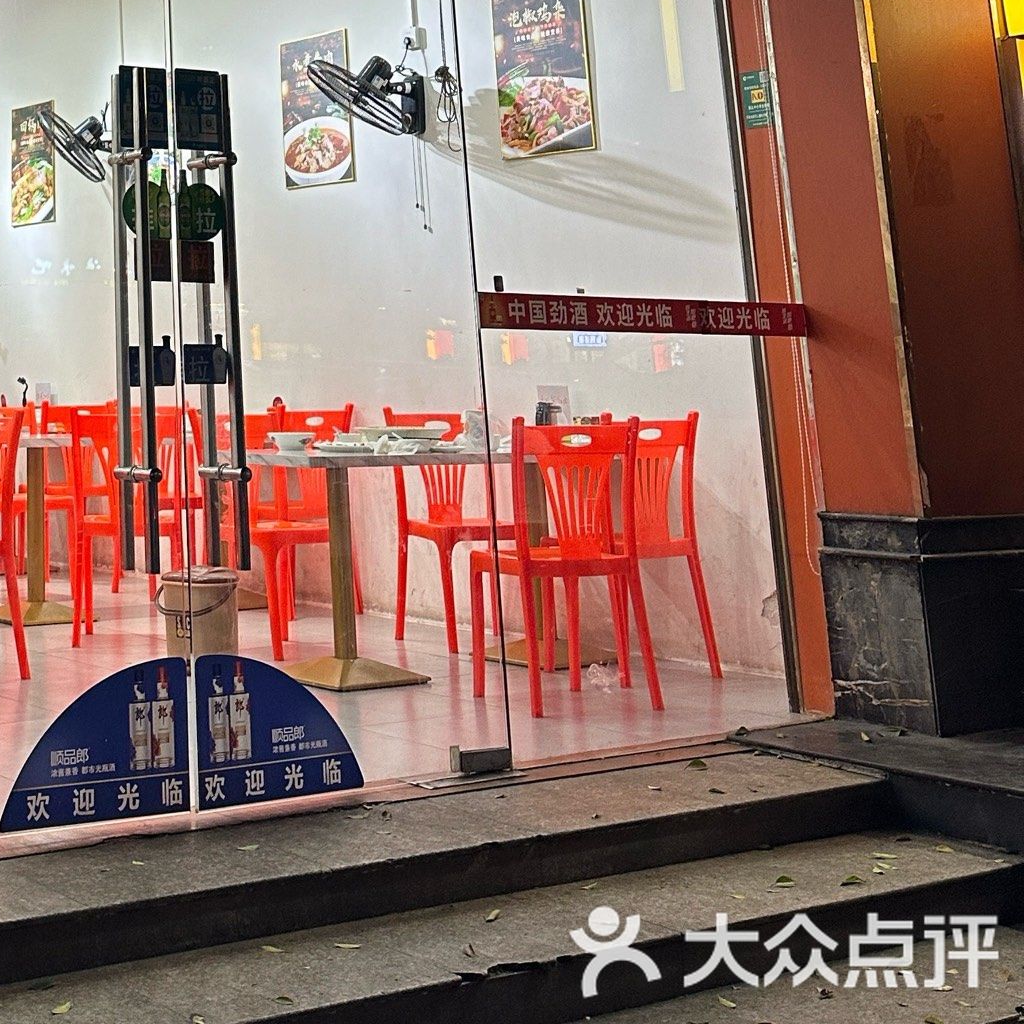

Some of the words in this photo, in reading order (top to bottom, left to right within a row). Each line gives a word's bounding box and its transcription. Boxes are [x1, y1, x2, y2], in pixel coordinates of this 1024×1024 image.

[195, 207, 218, 233] 拉
[508, 298, 589, 326] 中国劲酒
[596, 302, 674, 328] 欢迎光临
[699, 306, 771, 331] 欢迎光临
[271, 726, 305, 744] 顺品郎
[50, 748, 89, 766] 顺品郎
[205, 759, 342, 802] 欢迎光临
[26, 779, 183, 823] 欢迎光临
